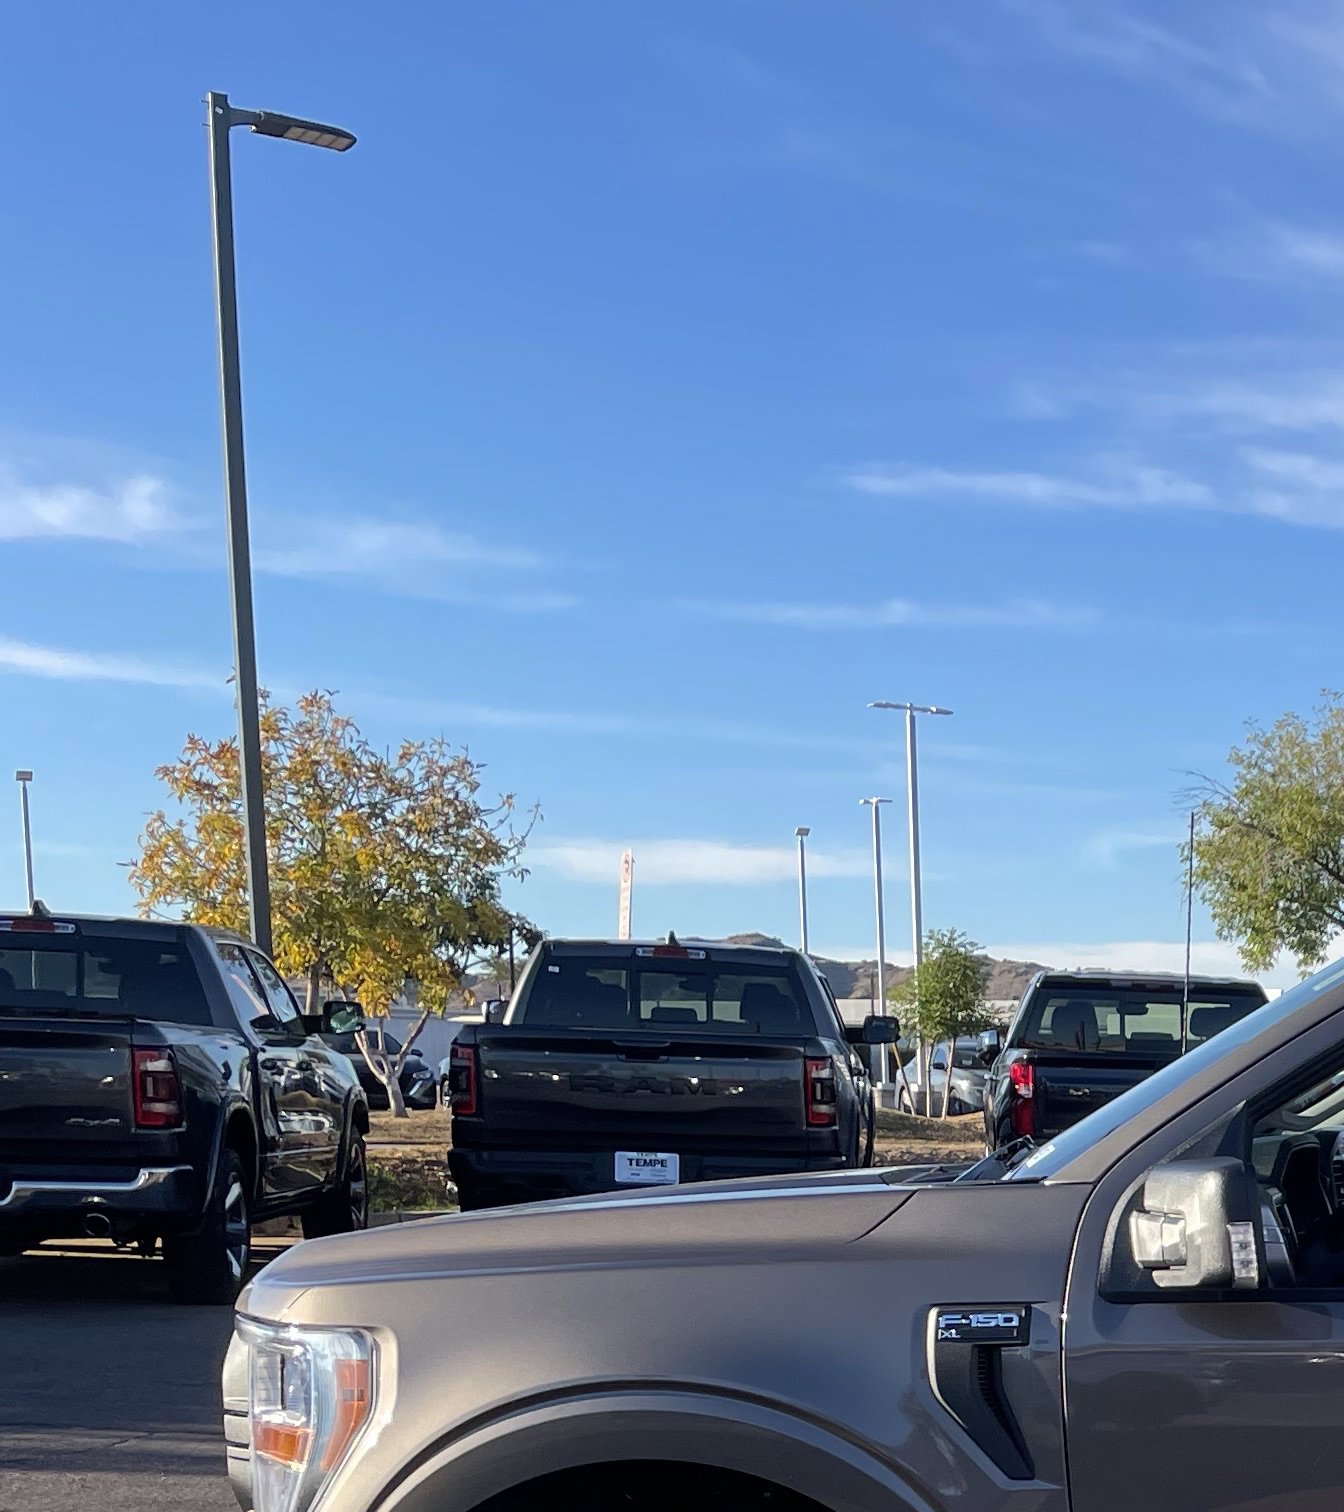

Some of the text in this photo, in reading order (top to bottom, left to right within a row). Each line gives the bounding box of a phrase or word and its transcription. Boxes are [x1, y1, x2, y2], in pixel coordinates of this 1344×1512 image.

[627, 1158, 668, 1168] TEMPE
[938, 1313, 1020, 1328] F-150
[940, 1328, 961, 1339] XL
